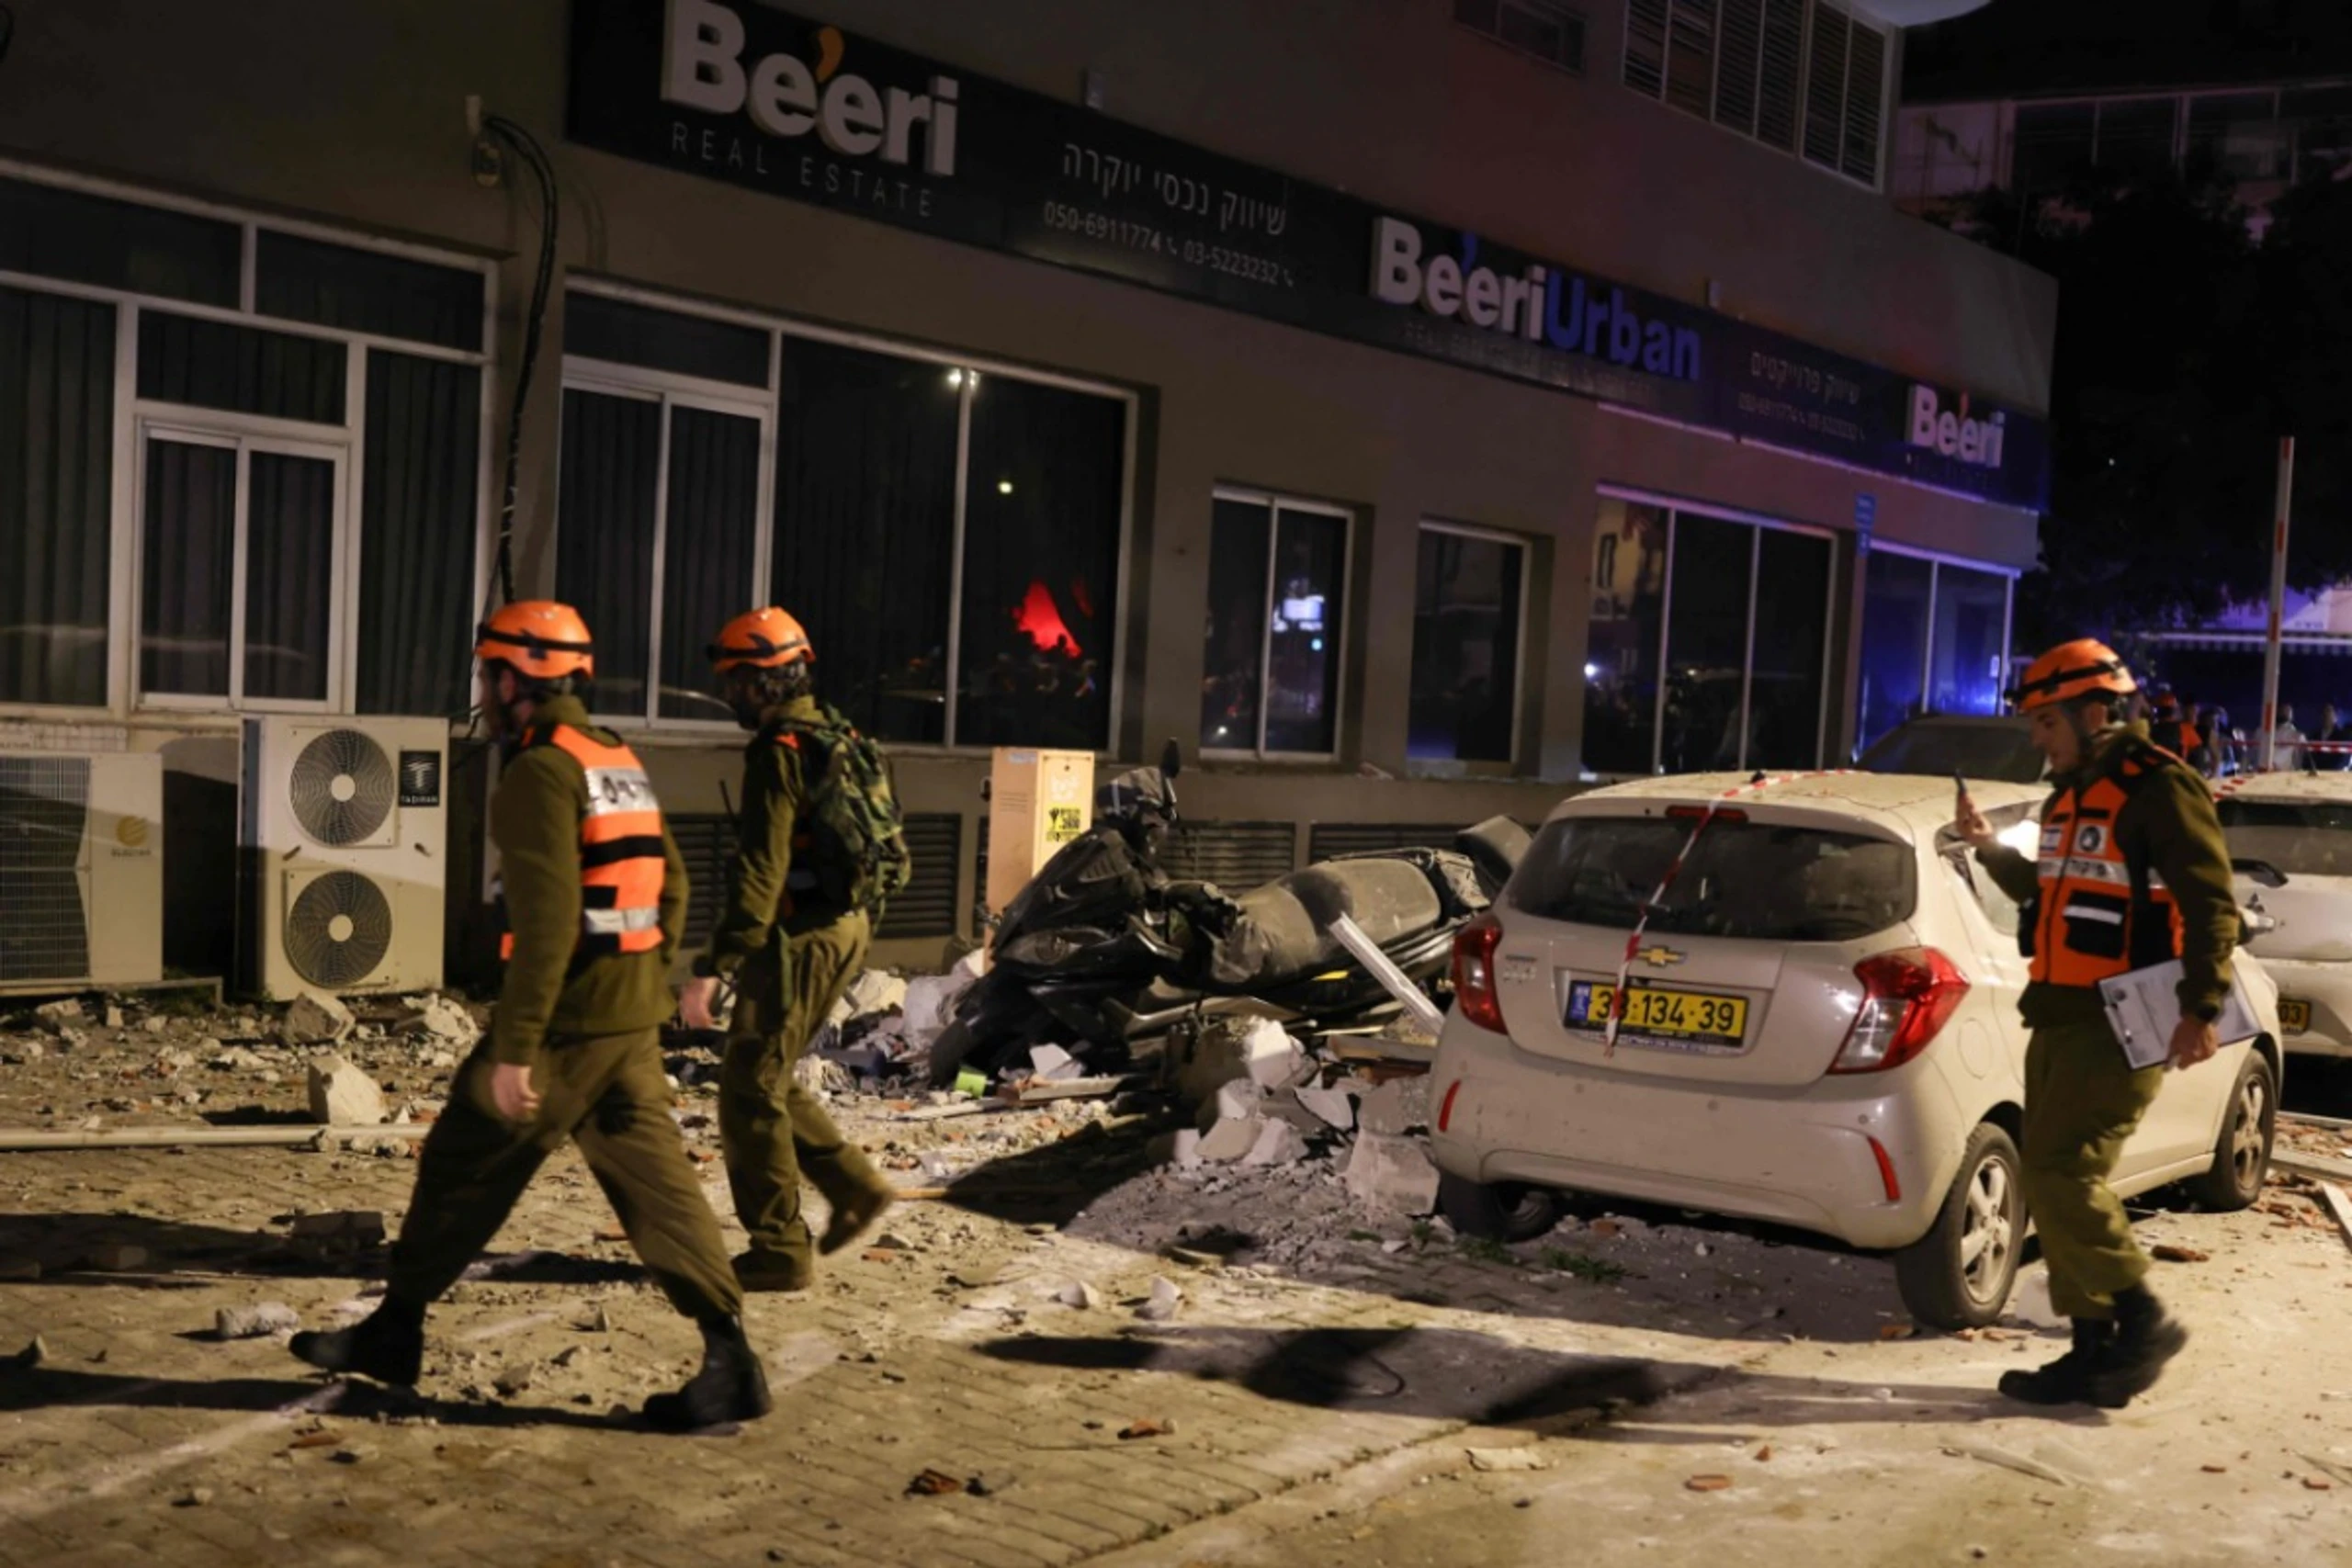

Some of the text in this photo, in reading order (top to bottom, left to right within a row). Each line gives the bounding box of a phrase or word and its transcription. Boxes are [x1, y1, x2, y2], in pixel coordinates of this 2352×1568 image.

[672, 121, 931, 218] REAL ESTATE
[1064, 143, 1286, 235] שיווק נכסי יוקרה
